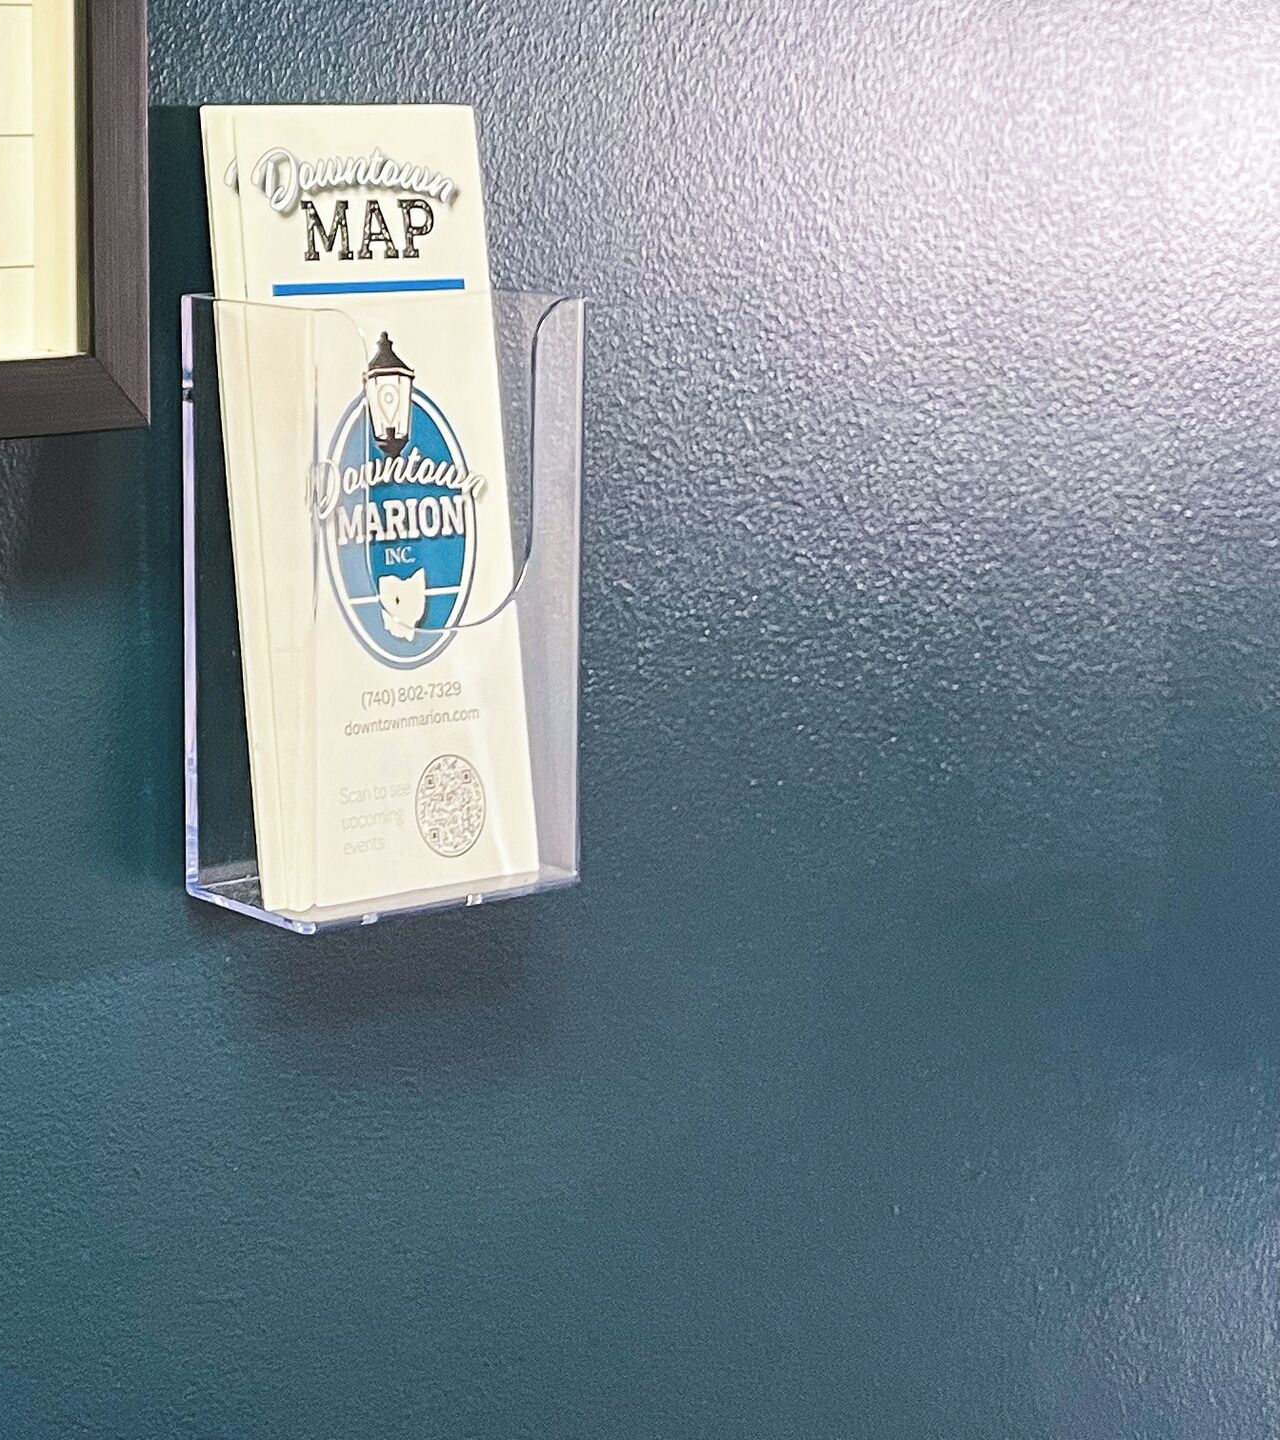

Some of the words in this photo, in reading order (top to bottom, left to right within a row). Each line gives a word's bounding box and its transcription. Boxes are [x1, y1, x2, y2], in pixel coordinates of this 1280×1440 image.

[251, 147, 458, 215] Downtown
[301, 198, 435, 262] MAP
[305, 447, 489, 520] Downtown
[336, 495, 467, 546] MARION
[384, 546, 416, 566] INC.
[361, 688, 396, 711] (740)
[397, 680, 462, 704] 802-7329
[344, 708, 480, 737] downtownmarion.com
[339, 786, 373, 806] Scan
[373, 784, 388, 801] to
[390, 783, 412, 799] see
[342, 806, 405, 832] upcoming
